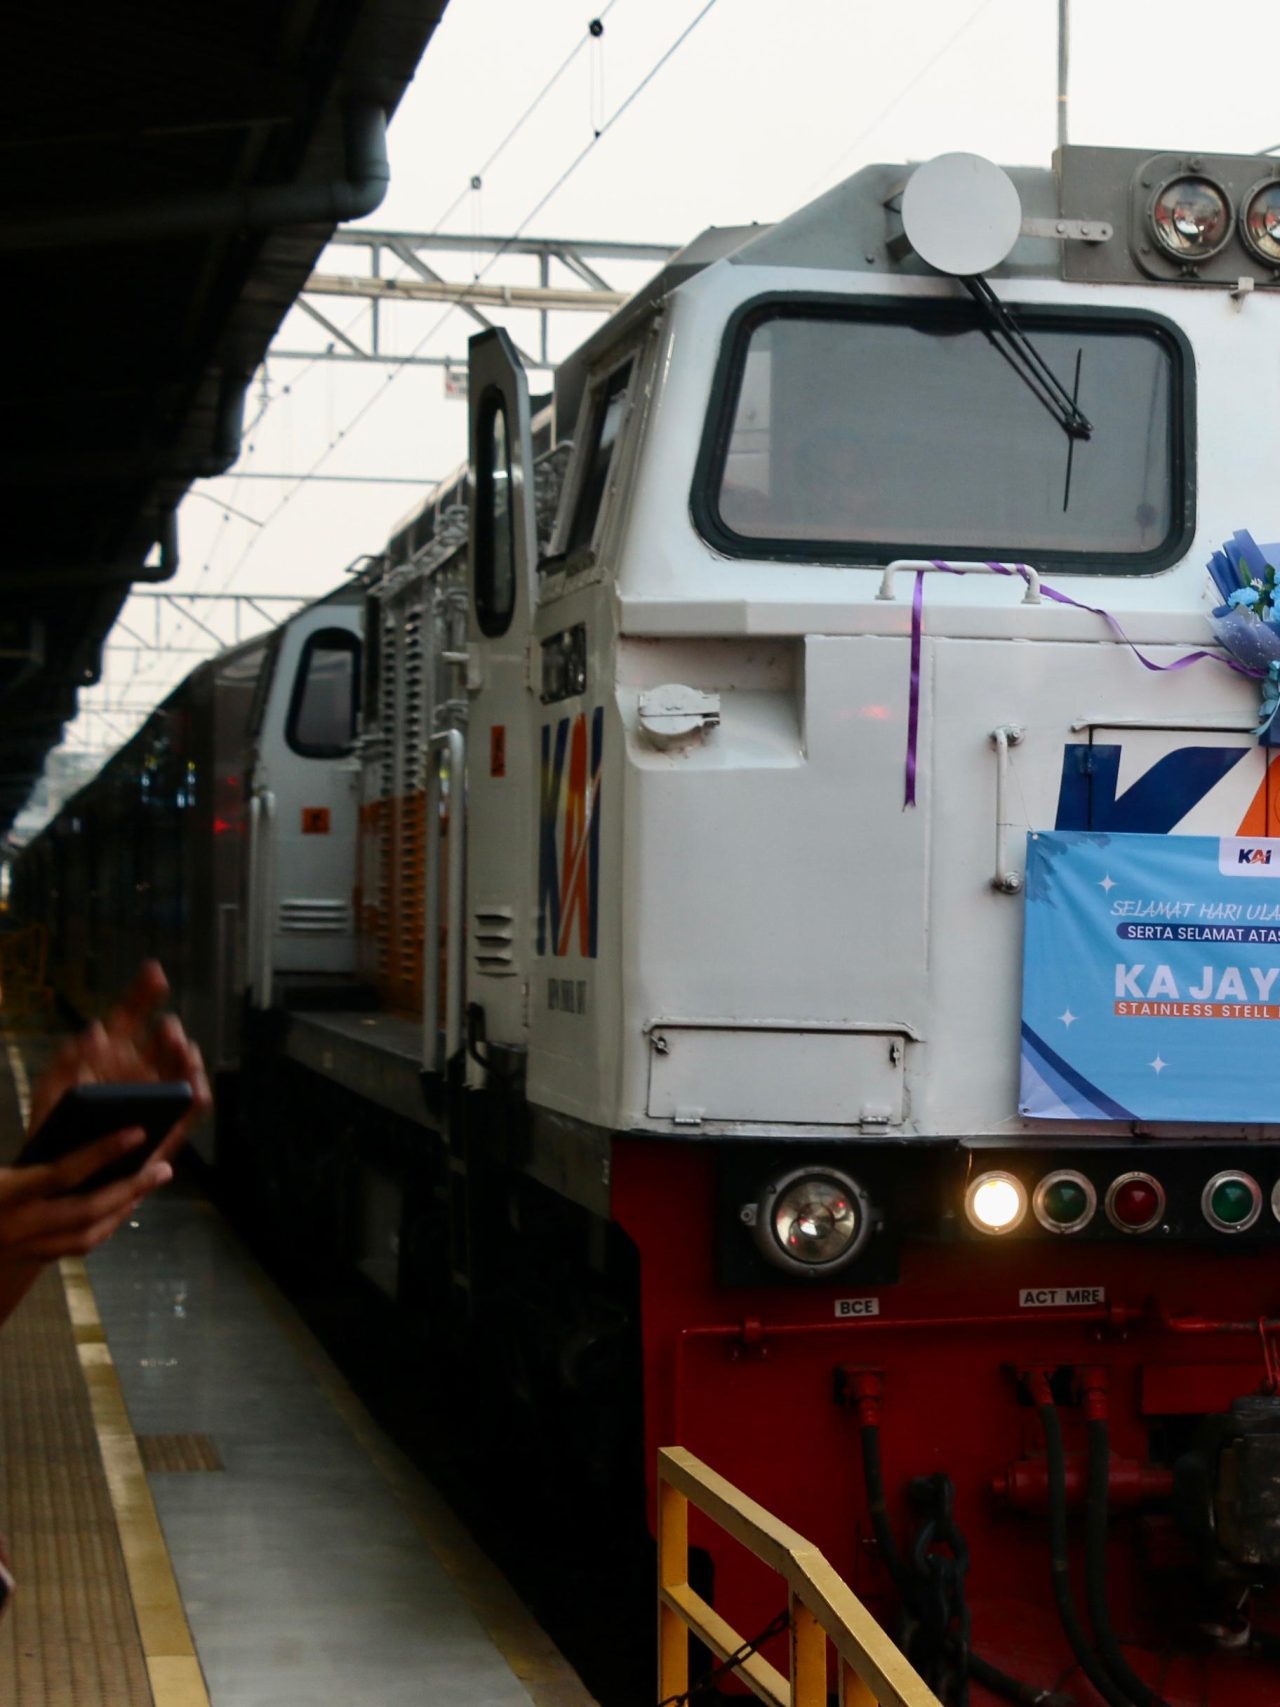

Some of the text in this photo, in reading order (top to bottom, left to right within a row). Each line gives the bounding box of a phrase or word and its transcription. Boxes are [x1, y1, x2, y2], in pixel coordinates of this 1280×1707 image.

[536, 706, 604, 959] KAI
[1111, 900, 1195, 919] SELAMAT
[1199, 902, 1244, 921] HARI
[1127, 925, 1174, 939] SERTA
[1177, 927, 1245, 941] SELAMAT
[1114, 963, 1180, 999] KA
[1117, 1002, 1213, 1017] STAINLESS
[1221, 1005, 1270, 1018] STELL
[1024, 1289, 1100, 1305] ACT MRE
[840, 1300, 873, 1315] BCE
